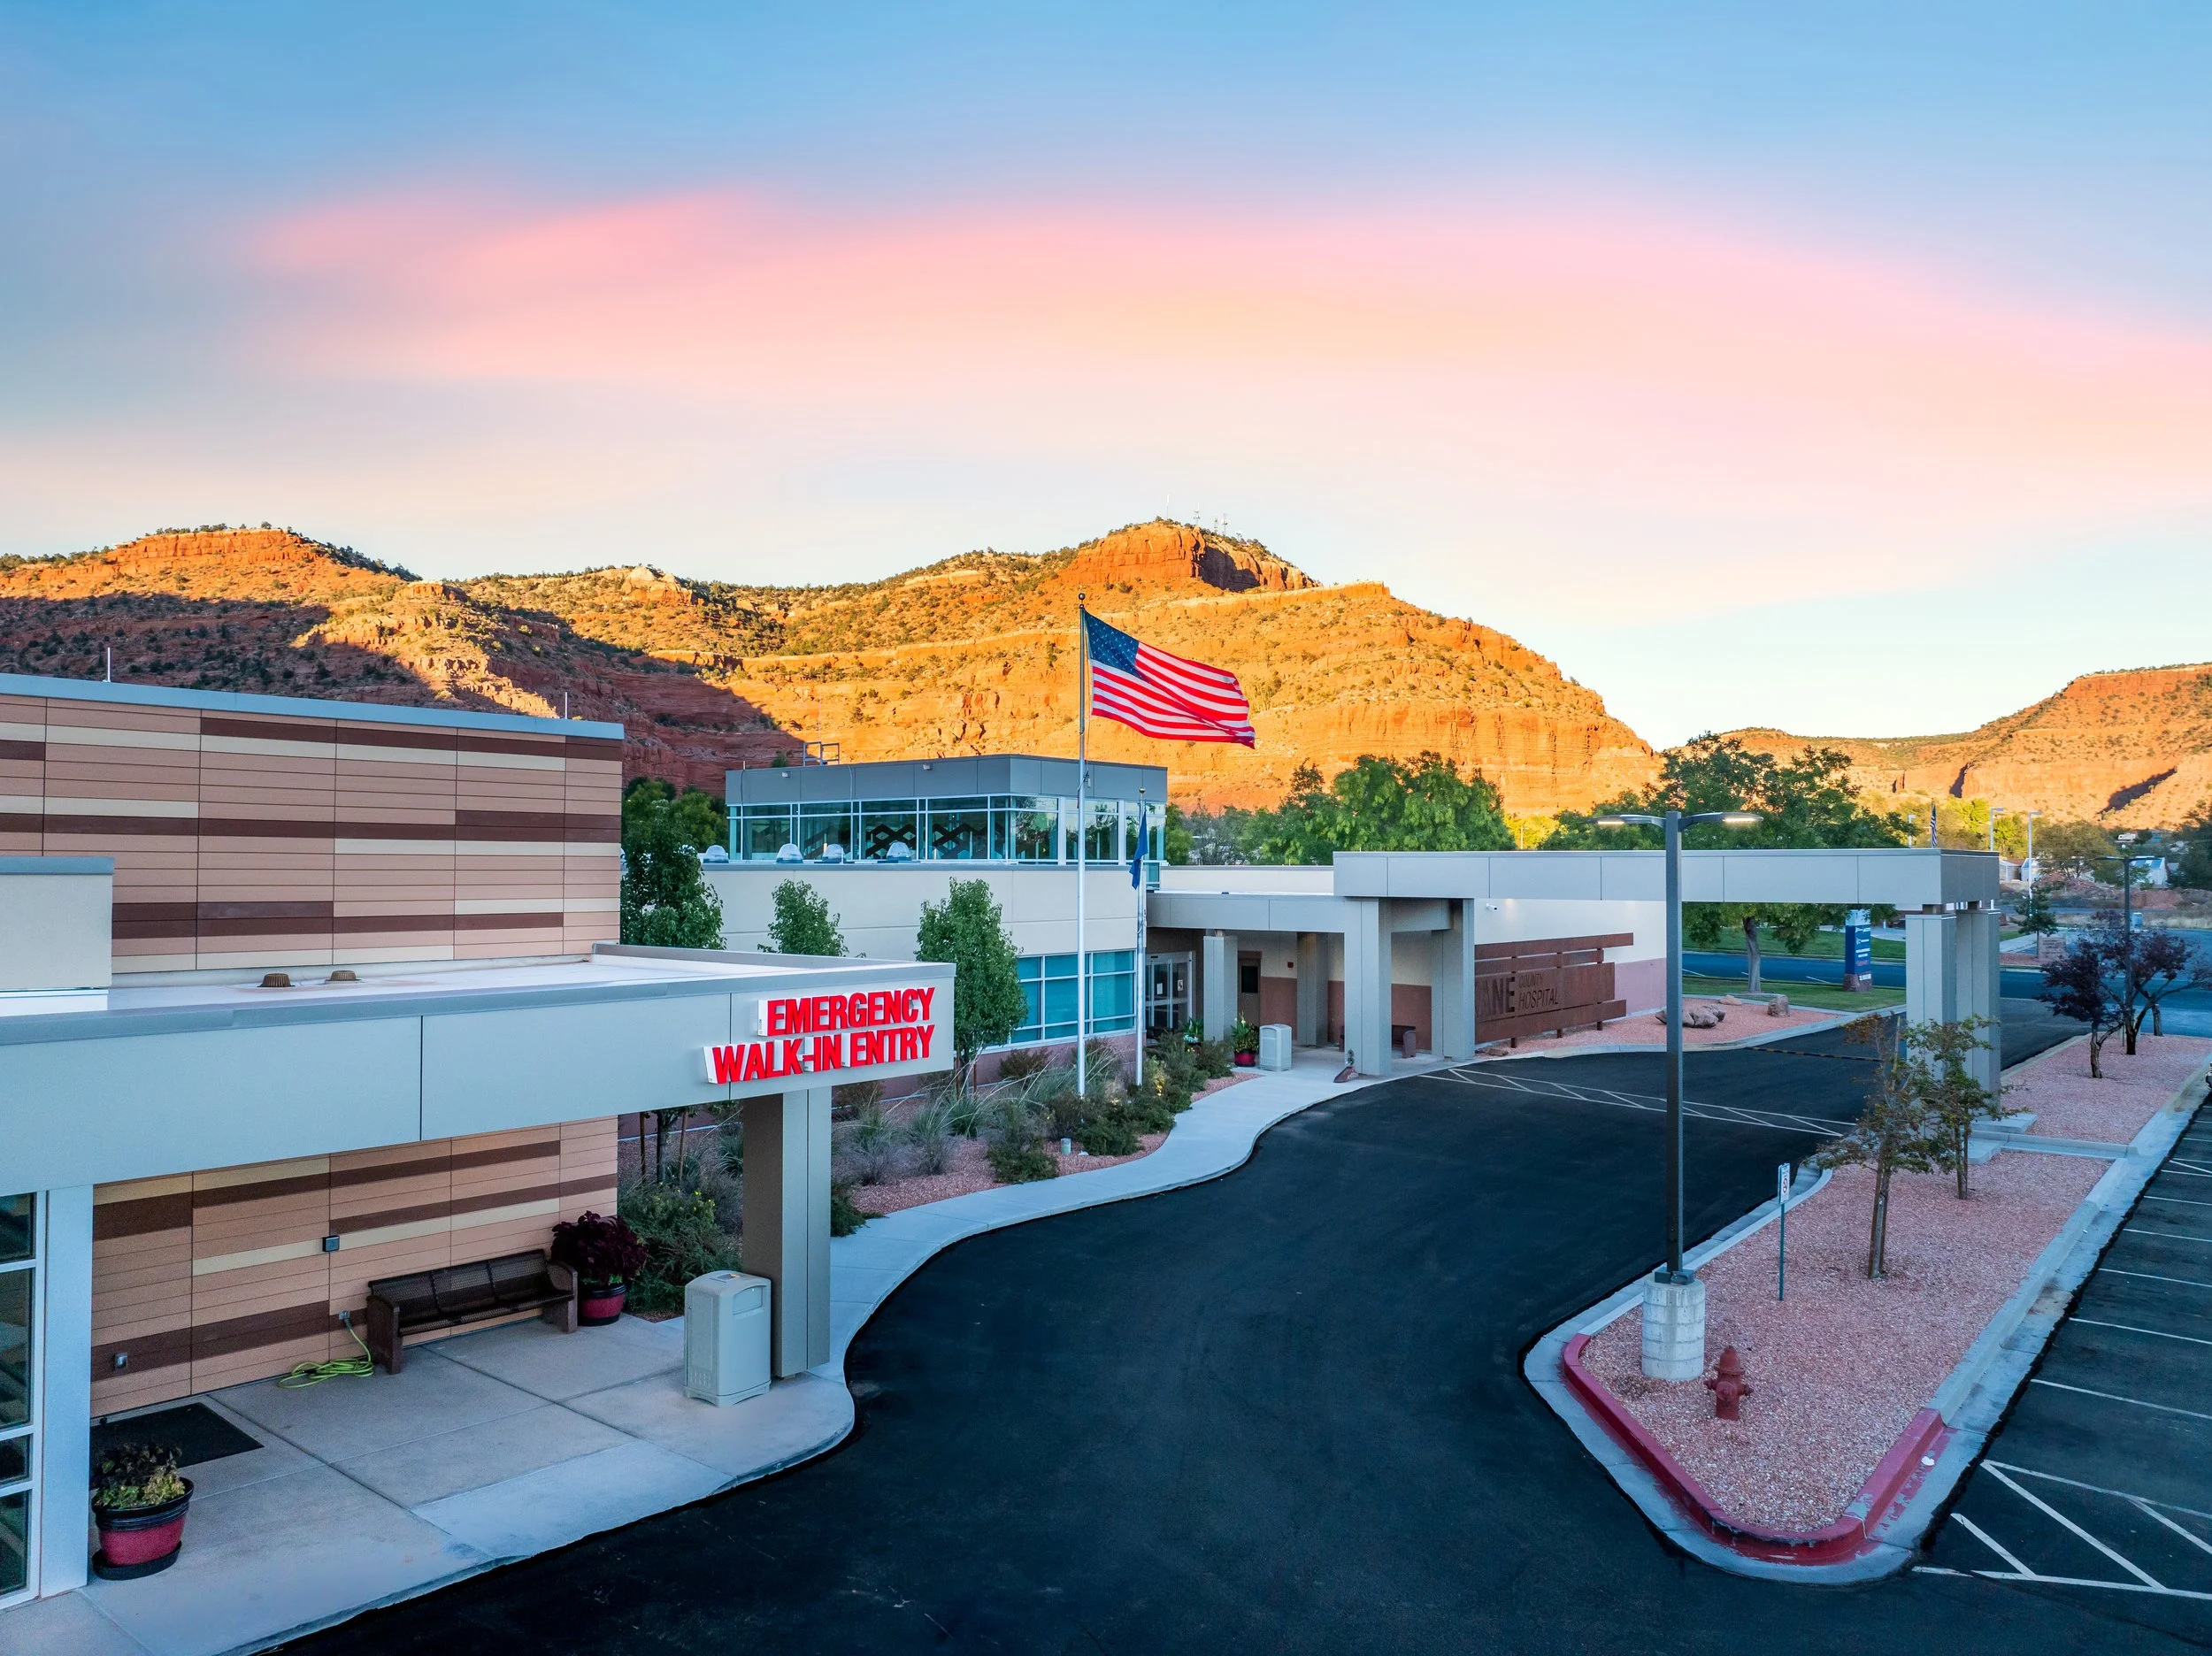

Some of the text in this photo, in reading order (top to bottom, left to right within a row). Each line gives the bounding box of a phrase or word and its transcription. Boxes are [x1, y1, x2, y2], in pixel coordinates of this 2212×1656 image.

[1475, 977, 1515, 1018] ANE
[1518, 973, 1543, 988] COUNTY
[1519, 988, 1558, 1010] HOSPITAL
[766, 986, 935, 1037] EMERGENCY
[711, 1024, 935, 1085] WALK-IN ENTRY
